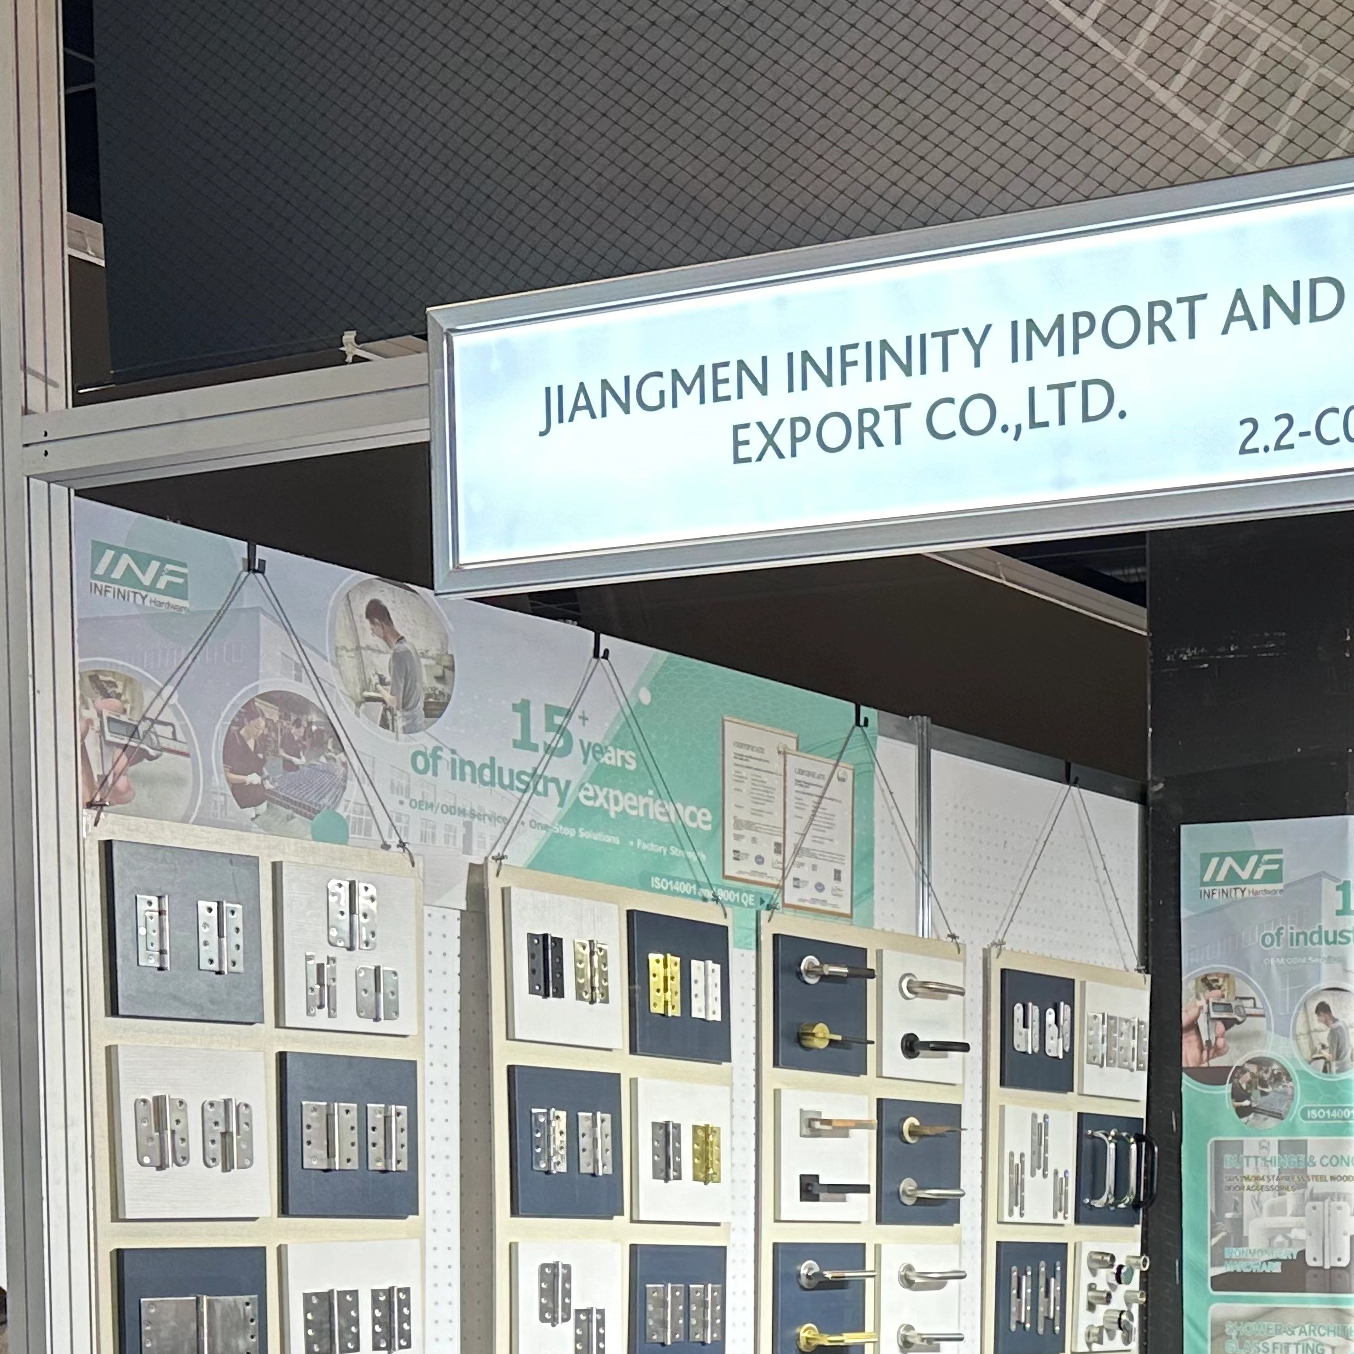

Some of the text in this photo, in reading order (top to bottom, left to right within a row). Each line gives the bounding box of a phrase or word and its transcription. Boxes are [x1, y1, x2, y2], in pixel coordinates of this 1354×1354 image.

[539, 276, 1346, 437] JIANGMEN INFINITY IMPORT AND
[732, 379, 1128, 465] EXPORT CO.,LTD.
[93, 549, 189, 591] INF
[89, 581, 149, 606] INFINITY
[580, 739, 637, 772] years
[410, 745, 444, 777] of
[449, 754, 572, 809] industry
[577, 781, 714, 832] experience
[1203, 854, 1283, 881] INF
[650, 876, 697, 895] ISO14001
[740, 891, 756, 907] QE
[1199, 888, 1247, 900] INFINITY
[1260, 927, 1285, 948] of
[1306, 1154, 1317, 1168] &
